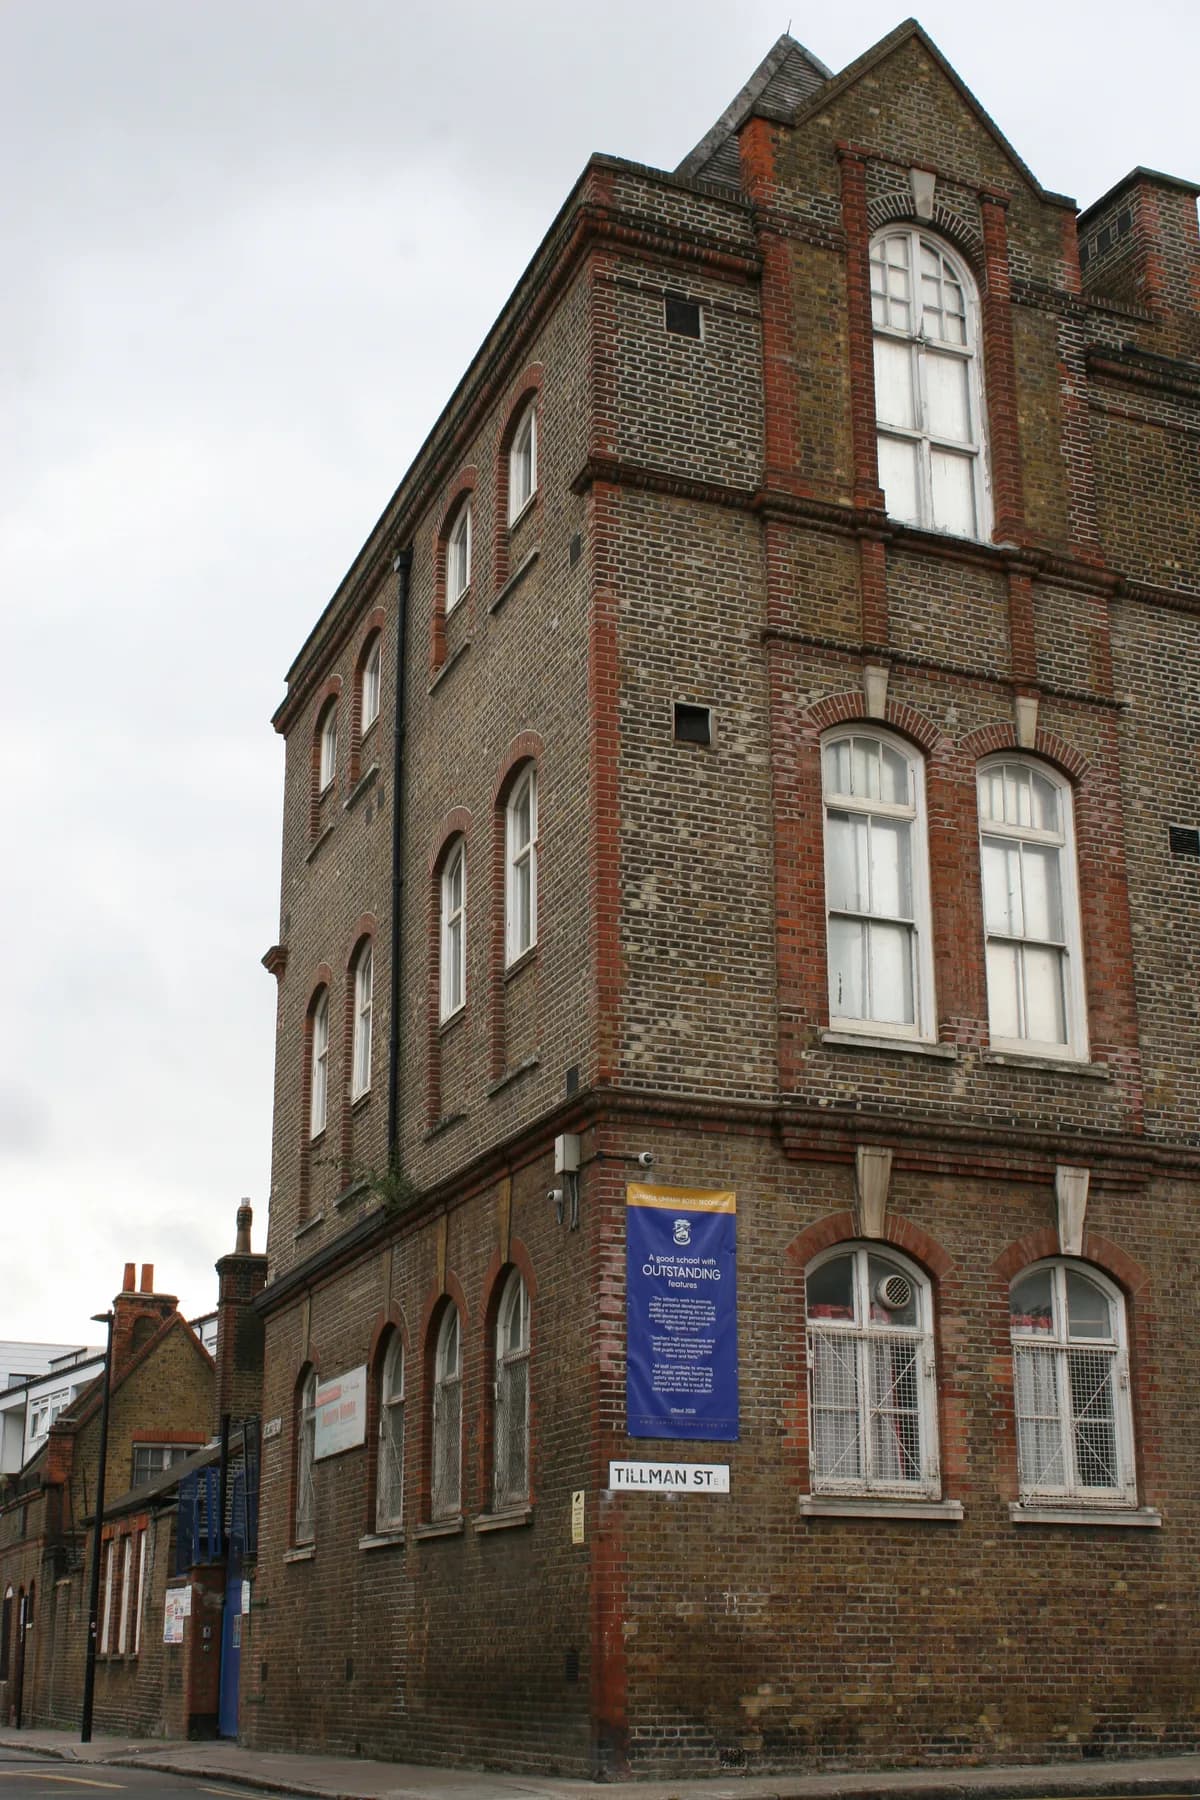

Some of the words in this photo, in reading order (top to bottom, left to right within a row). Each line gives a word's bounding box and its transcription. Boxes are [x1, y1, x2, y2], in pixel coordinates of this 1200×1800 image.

[649, 1253, 655, 1262] A
[655, 1255, 674, 1264] good
[676, 1256, 700, 1264] school
[701, 1257, 716, 1266] with
[642, 1264, 721, 1281] OUTSTANDING
[668, 1279, 698, 1289] features
[614, 1468, 687, 1485] TILLMAN
[693, 1470, 713, 1486] ST
